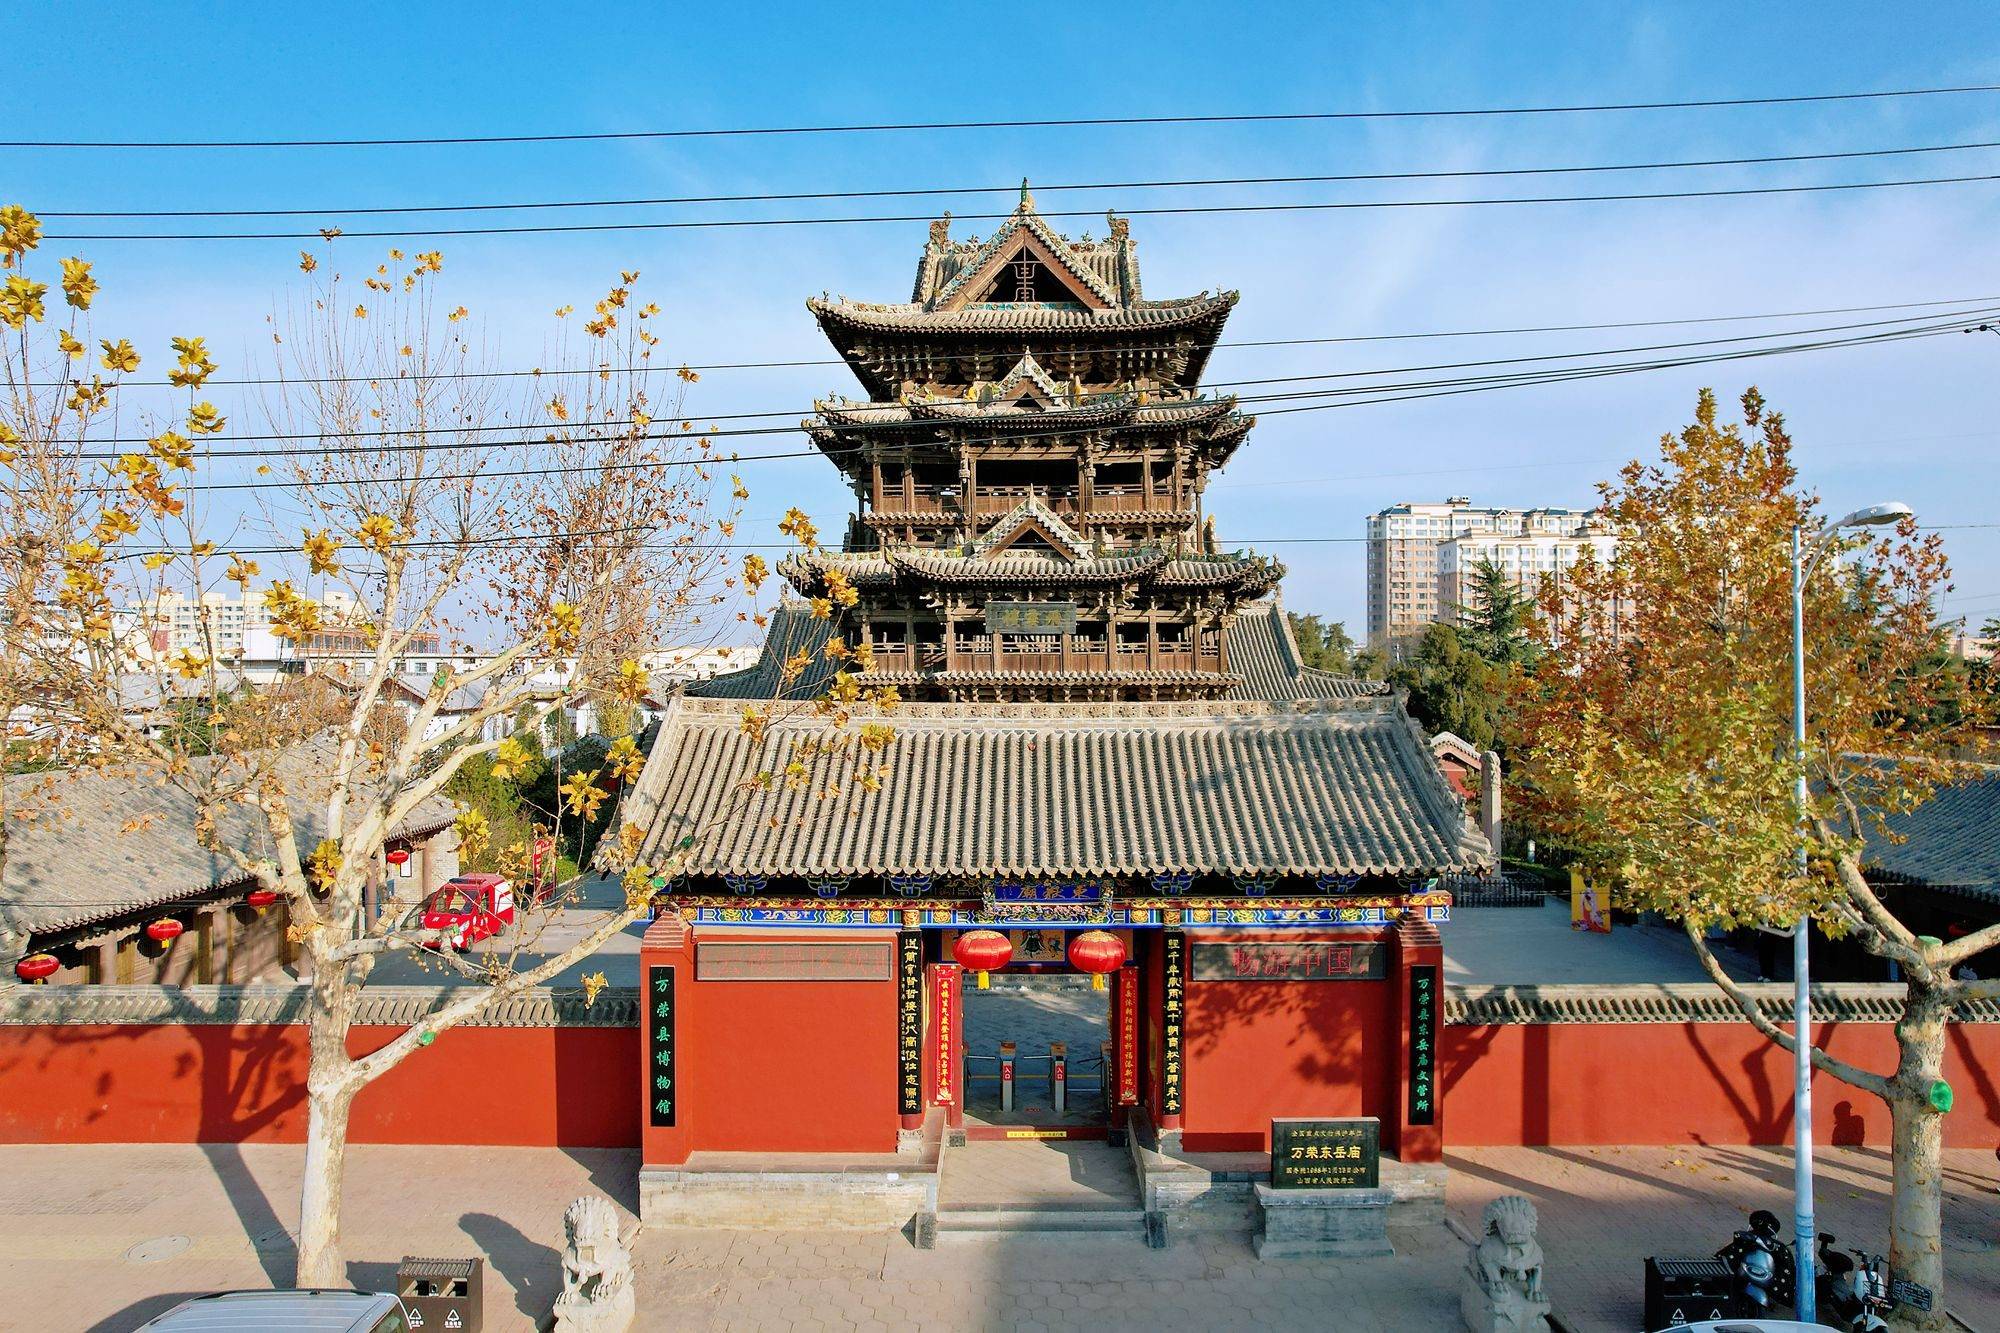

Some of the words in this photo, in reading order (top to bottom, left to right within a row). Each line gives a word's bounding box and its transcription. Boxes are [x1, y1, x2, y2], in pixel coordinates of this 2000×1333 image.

[655, 977, 671, 1115] 万荣县博物馆
[1415, 978, 1429, 1113] 万荣县东岳庙文管所
[1291, 1146, 1361, 1159] 万荣东岳庙
